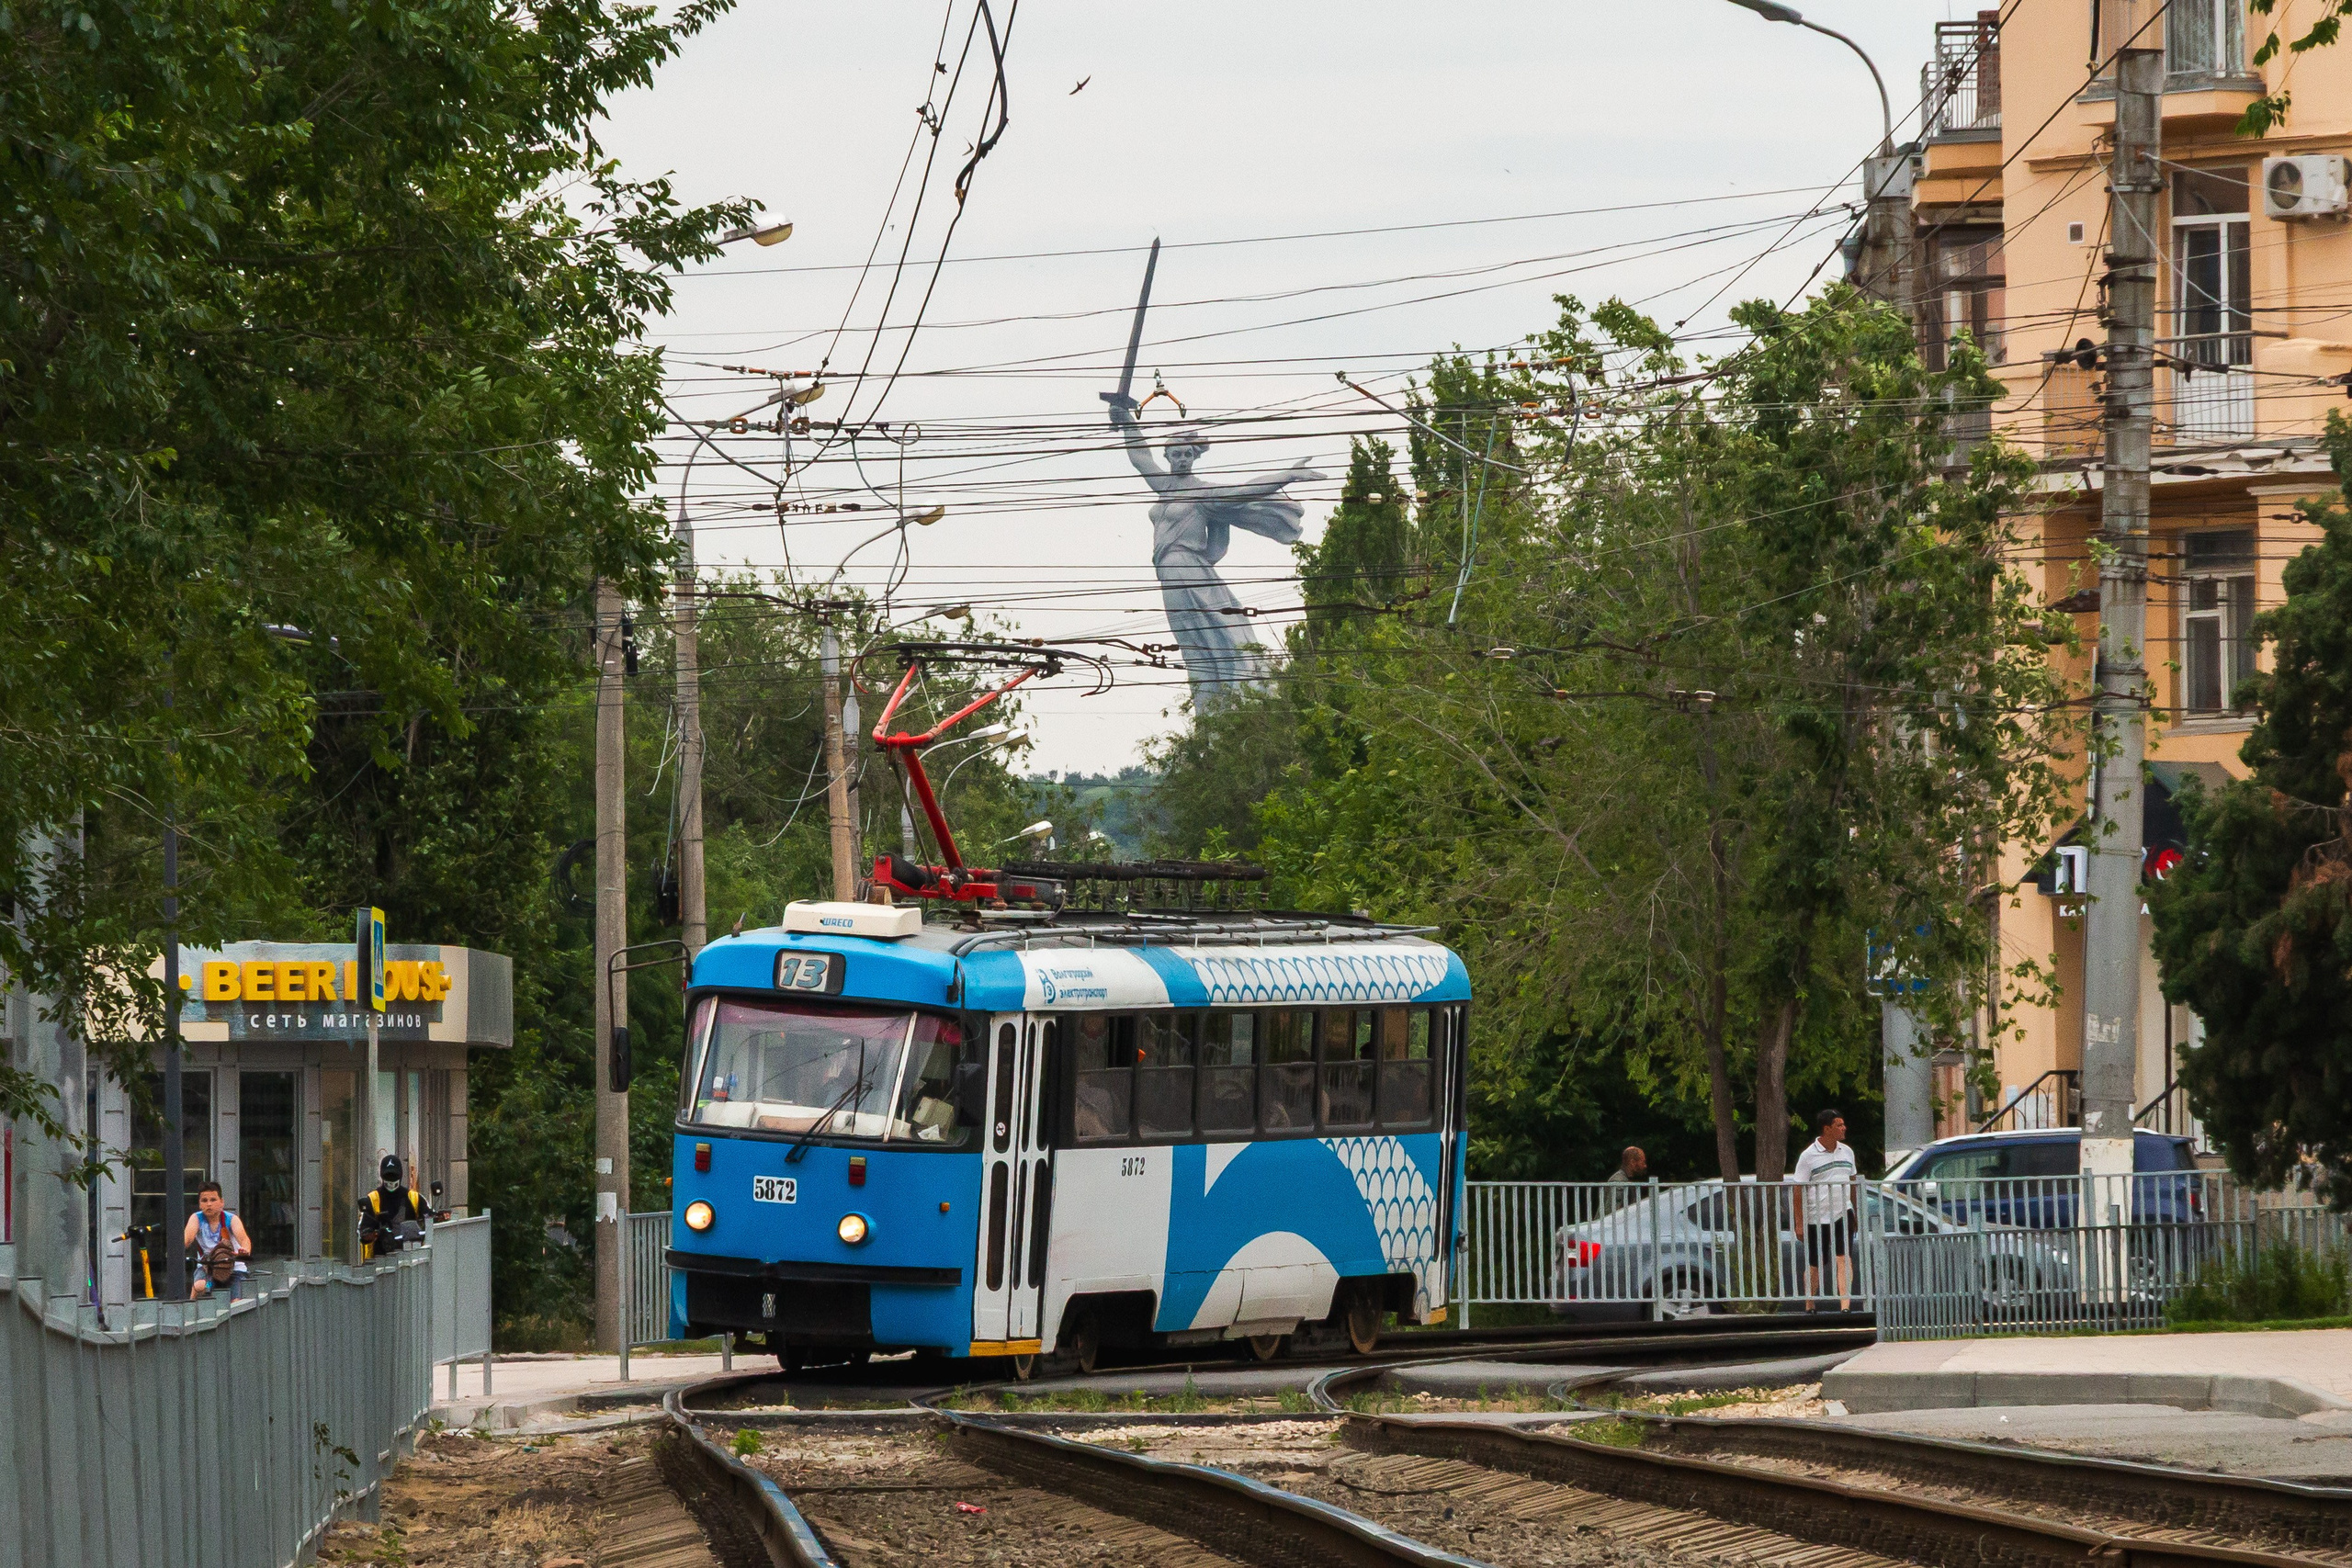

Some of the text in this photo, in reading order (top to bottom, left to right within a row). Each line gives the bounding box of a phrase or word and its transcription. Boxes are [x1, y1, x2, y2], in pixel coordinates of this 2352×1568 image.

[202, 961, 338, 1001] BEER
[782, 958, 827, 988] 13
[250, 1013, 307, 1028] сеть
[1121, 1156, 1146, 1177] 5872
[754, 1179, 796, 1201] 5872
